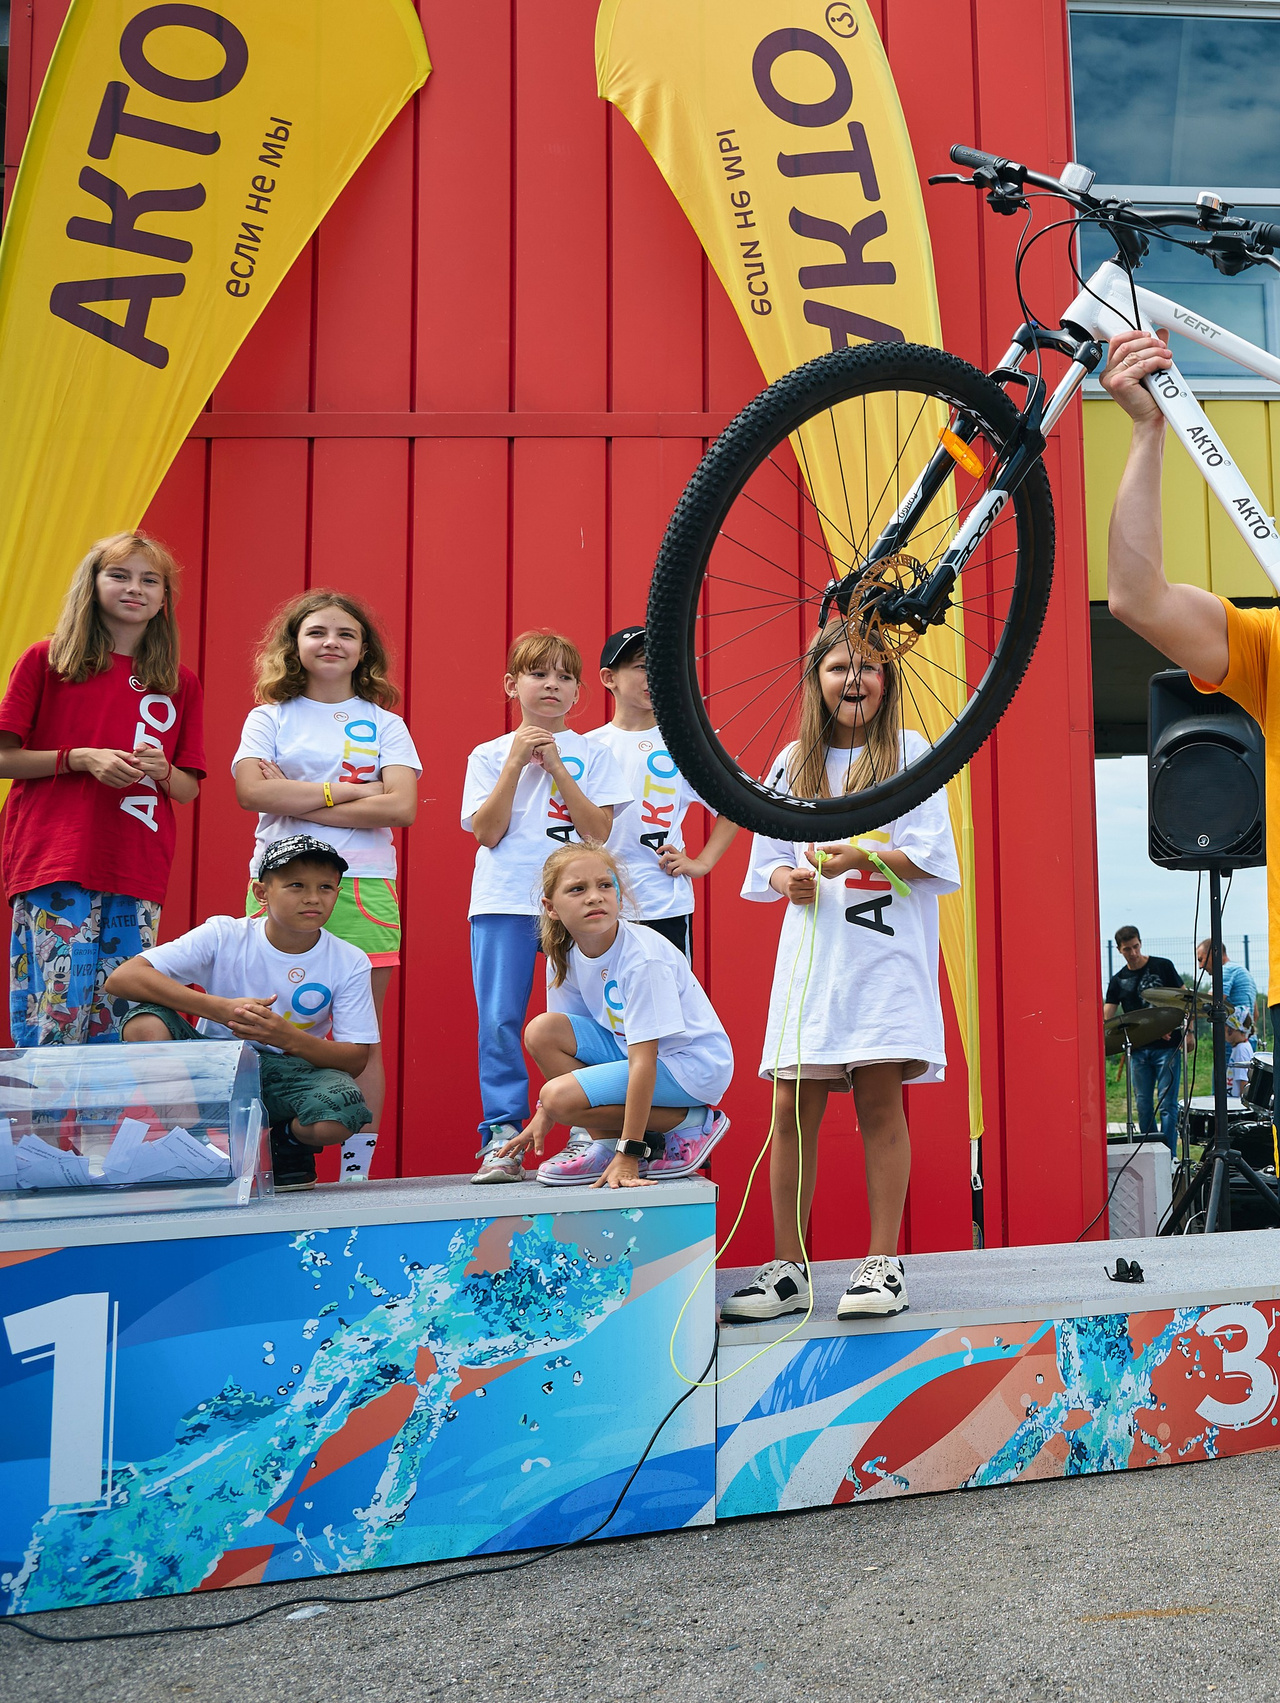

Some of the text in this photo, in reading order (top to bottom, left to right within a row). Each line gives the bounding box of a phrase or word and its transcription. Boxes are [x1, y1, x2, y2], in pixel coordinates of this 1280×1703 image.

[50, 3, 249, 369] АКТО
[225, 116, 293, 299] если не мы
[1173, 308, 1221, 339] VERT
[1150, 368, 1180, 399] КТО
[1186, 426, 1224, 467] АКТО
[1232, 497, 1271, 540] АКТО
[120, 693, 177, 833] АТО
[339, 719, 378, 784] КТО
[546, 756, 585, 844] АКО
[3, 1292, 115, 1510] 1
[1194, 1304, 1279, 1430] 3
